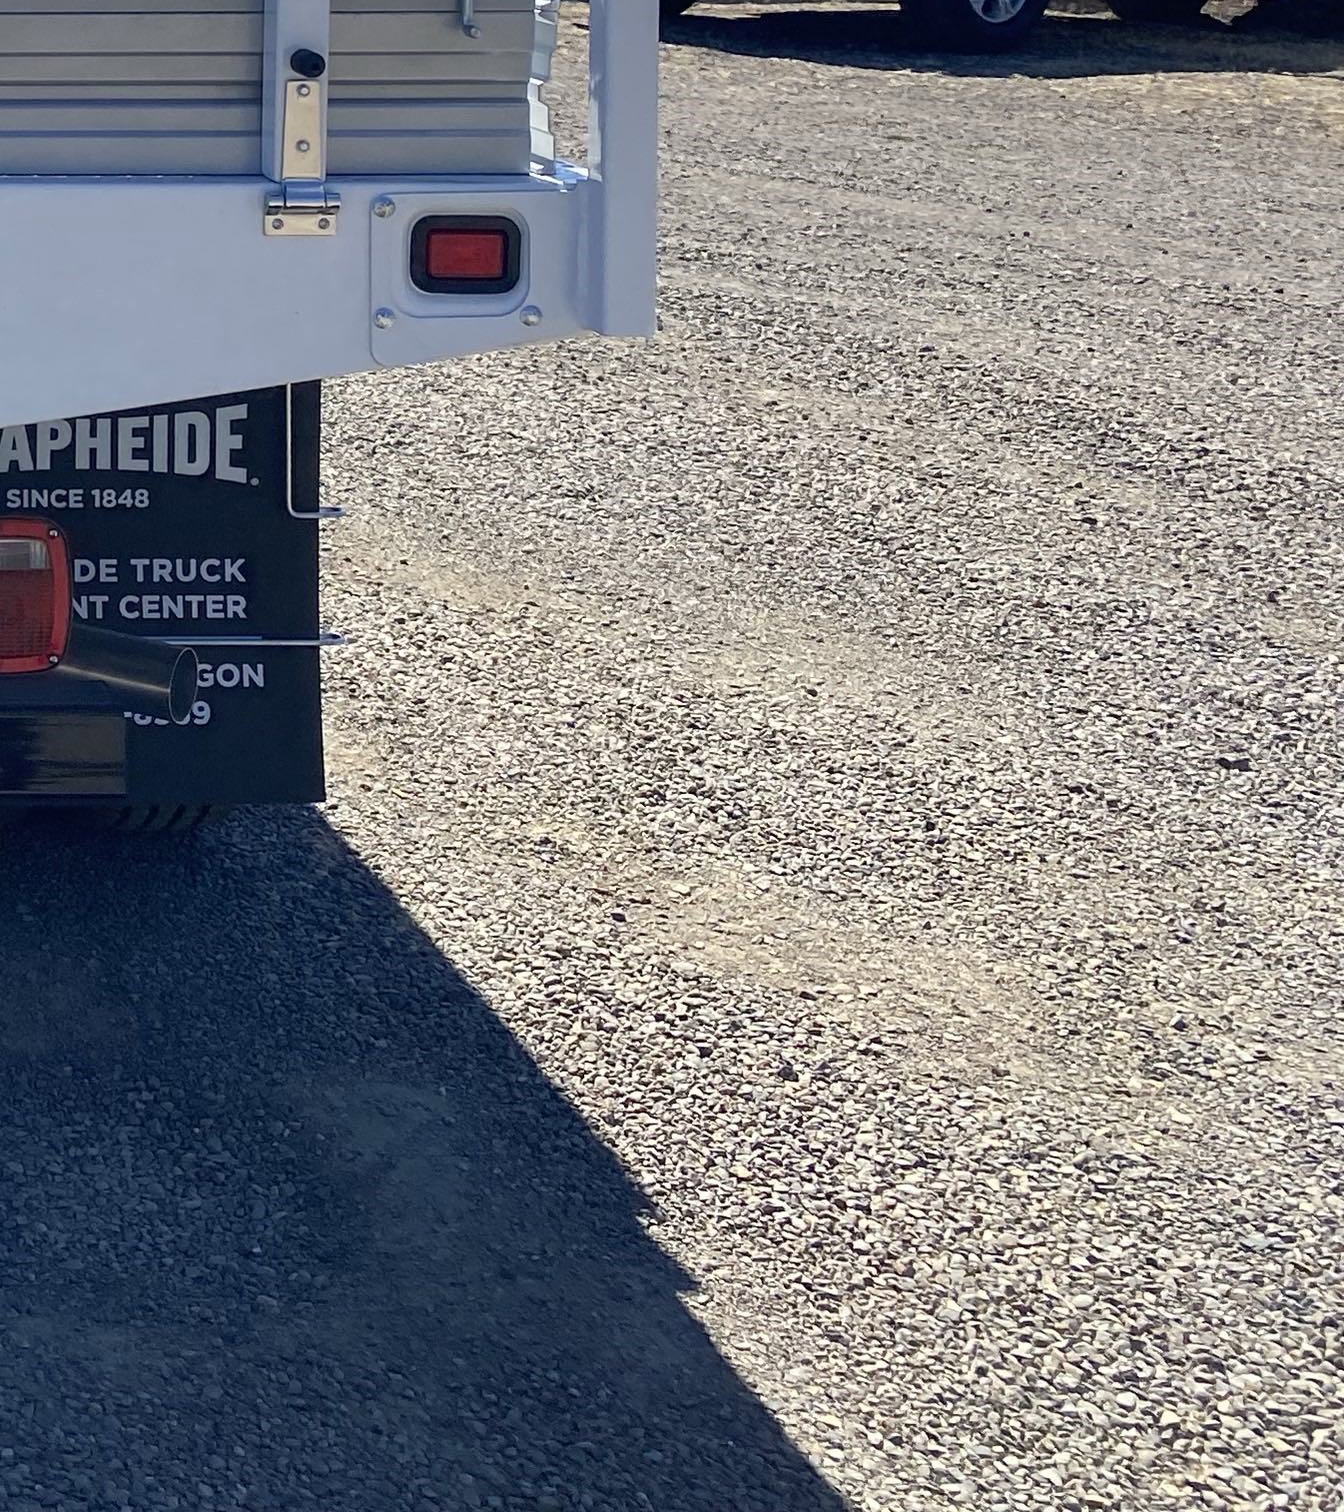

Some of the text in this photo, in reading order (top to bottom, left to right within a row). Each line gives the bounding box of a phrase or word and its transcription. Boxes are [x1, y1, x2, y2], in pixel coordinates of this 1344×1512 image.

[6, 488, 150, 509] SINCE 1848
[130, 558, 247, 583] TRUCK
[119, 595, 248, 619] CENTER
